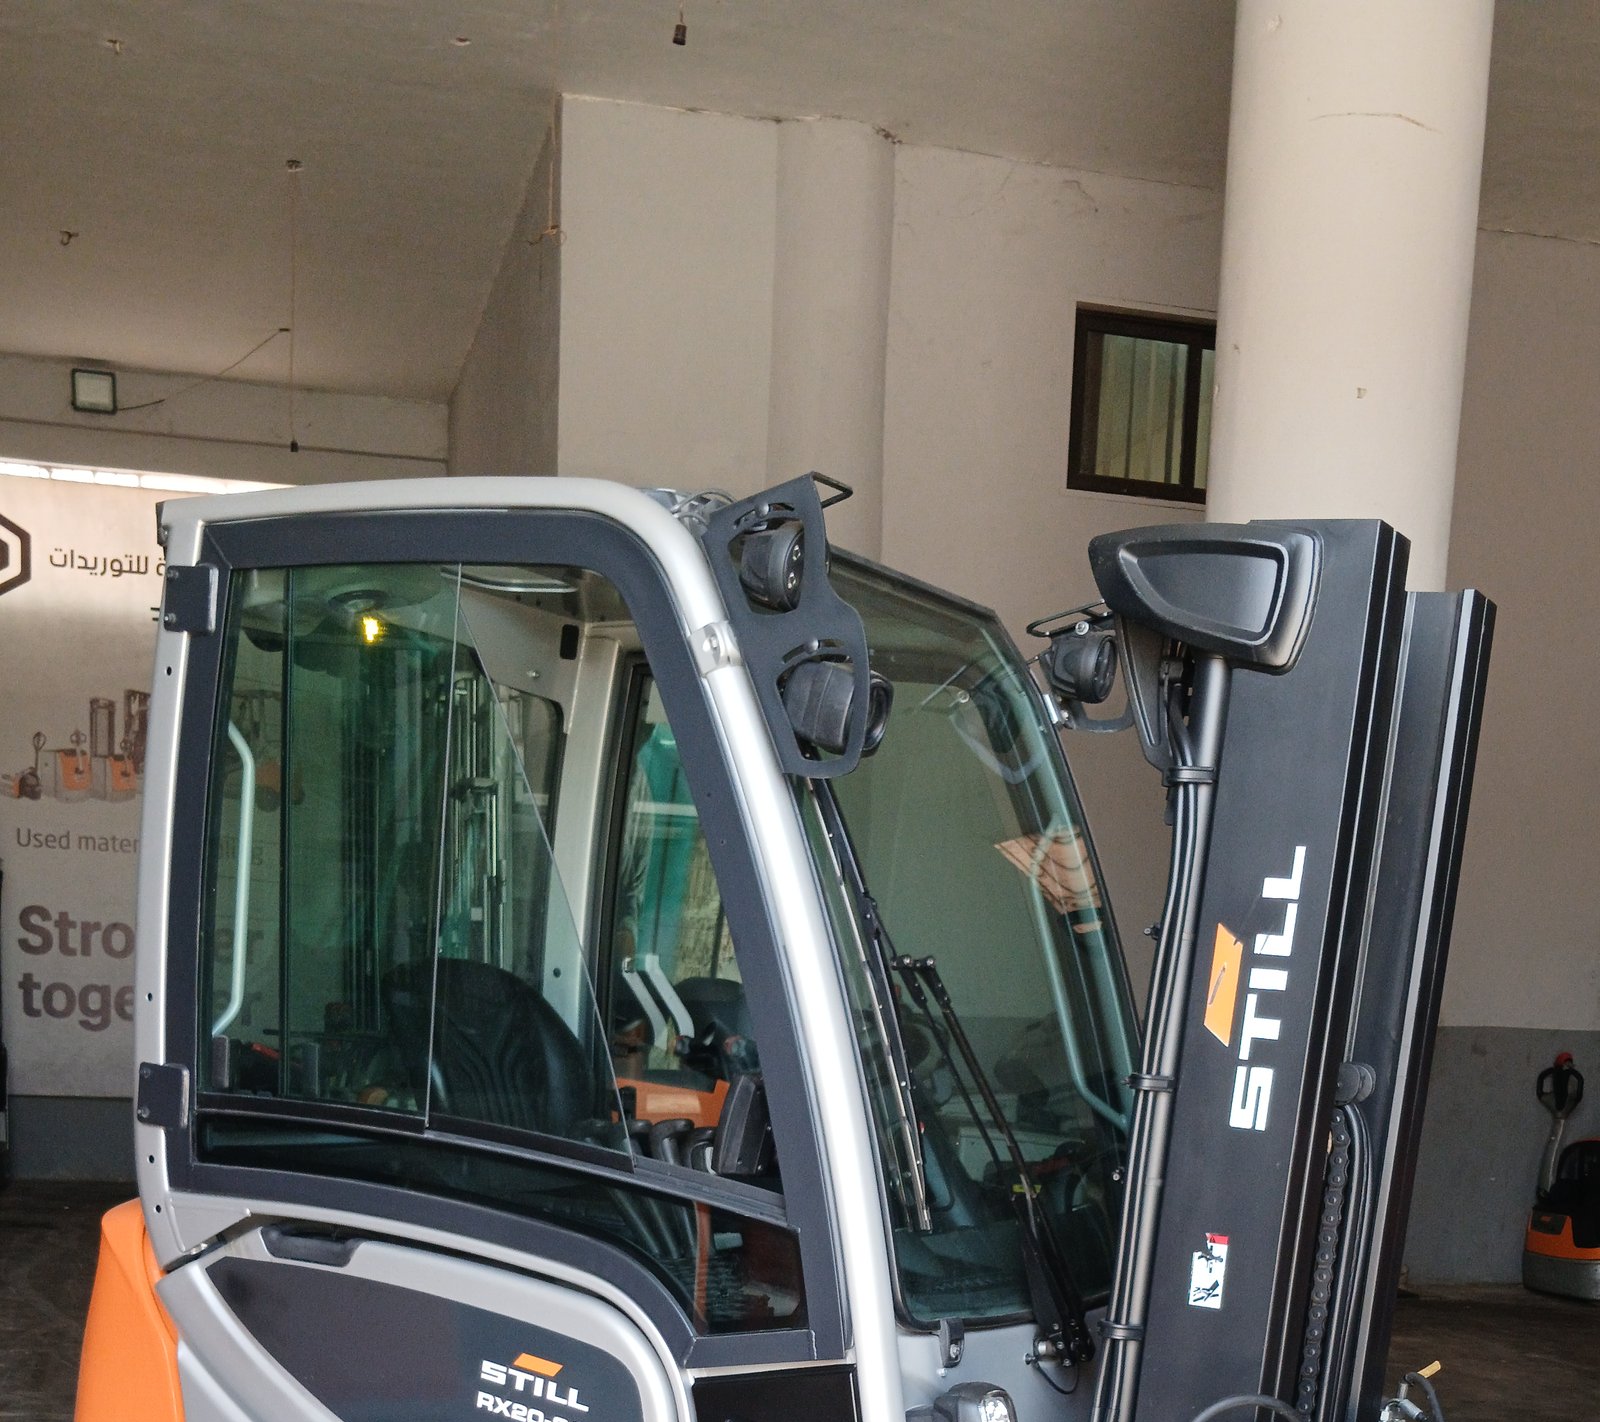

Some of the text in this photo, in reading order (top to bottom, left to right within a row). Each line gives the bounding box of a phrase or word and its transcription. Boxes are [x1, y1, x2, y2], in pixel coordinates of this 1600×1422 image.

[50, 548, 148, 577] للتوريدات
[16, 828, 139, 853] Used mater
[18, 905, 135, 960] Stro
[18, 972, 134, 1032] toge
[1229, 846, 1306, 1131] STILL
[480, 1359, 589, 1412] STILL
